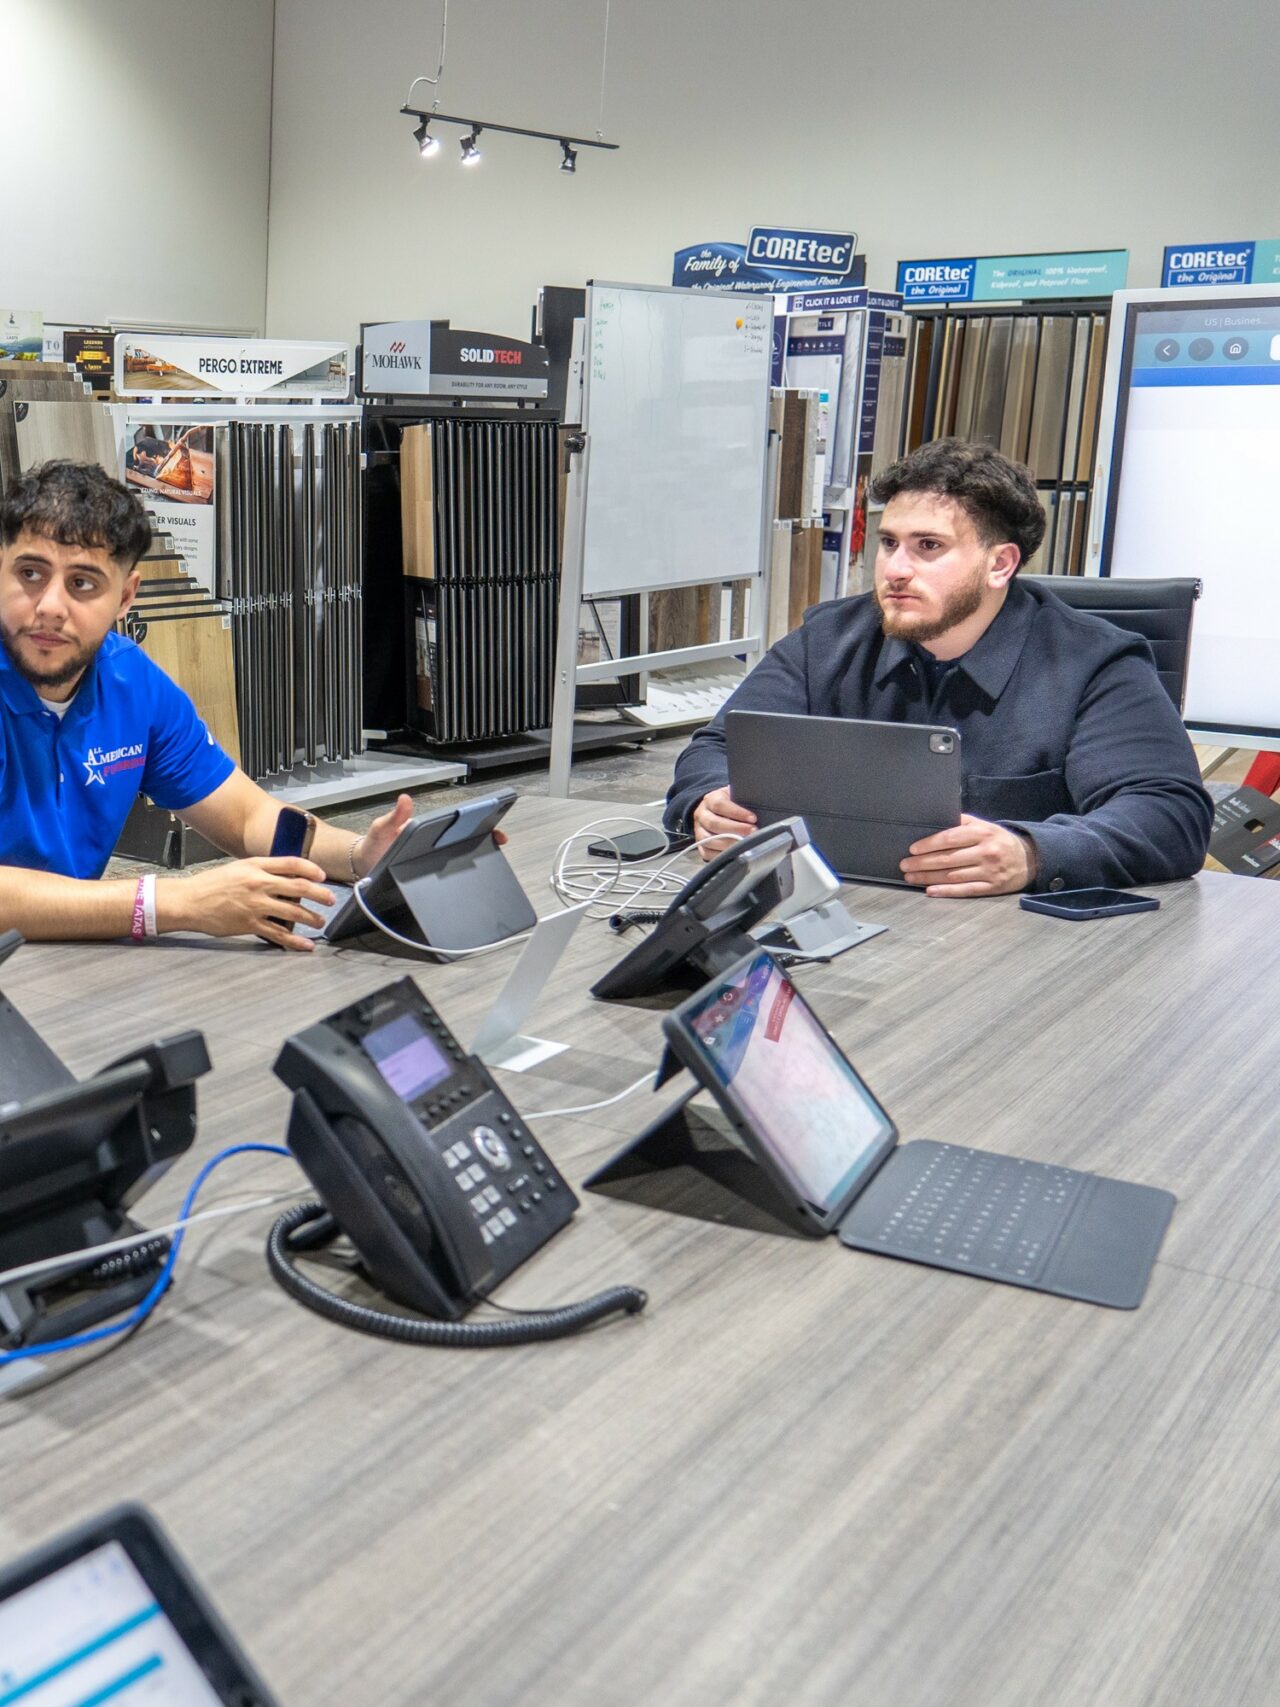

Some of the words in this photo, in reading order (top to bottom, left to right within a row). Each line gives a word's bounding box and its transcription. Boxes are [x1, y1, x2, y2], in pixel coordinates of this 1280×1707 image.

[700, 249, 712, 258] the
[684, 255, 727, 277] Family
[728, 257, 741, 273] of
[1176, 273, 1195, 283] the
[1197, 270, 1237, 284] Original
[910, 286, 926, 295] the
[928, 284, 961, 297] Original
[805, 297, 823, 307] CLICK
[823, 296, 830, 306] IT
[836, 295, 853, 305] LOVE
[853, 294, 860, 303] IT
[1204, 317, 1218, 327] US
[372, 354, 422, 370] MOHAWK
[459, 348, 523, 365] SOLIDTECH
[198, 357, 237, 375] PERGO
[240, 359, 284, 375] EXTREME
[167, 516, 197, 526] VISUALS
